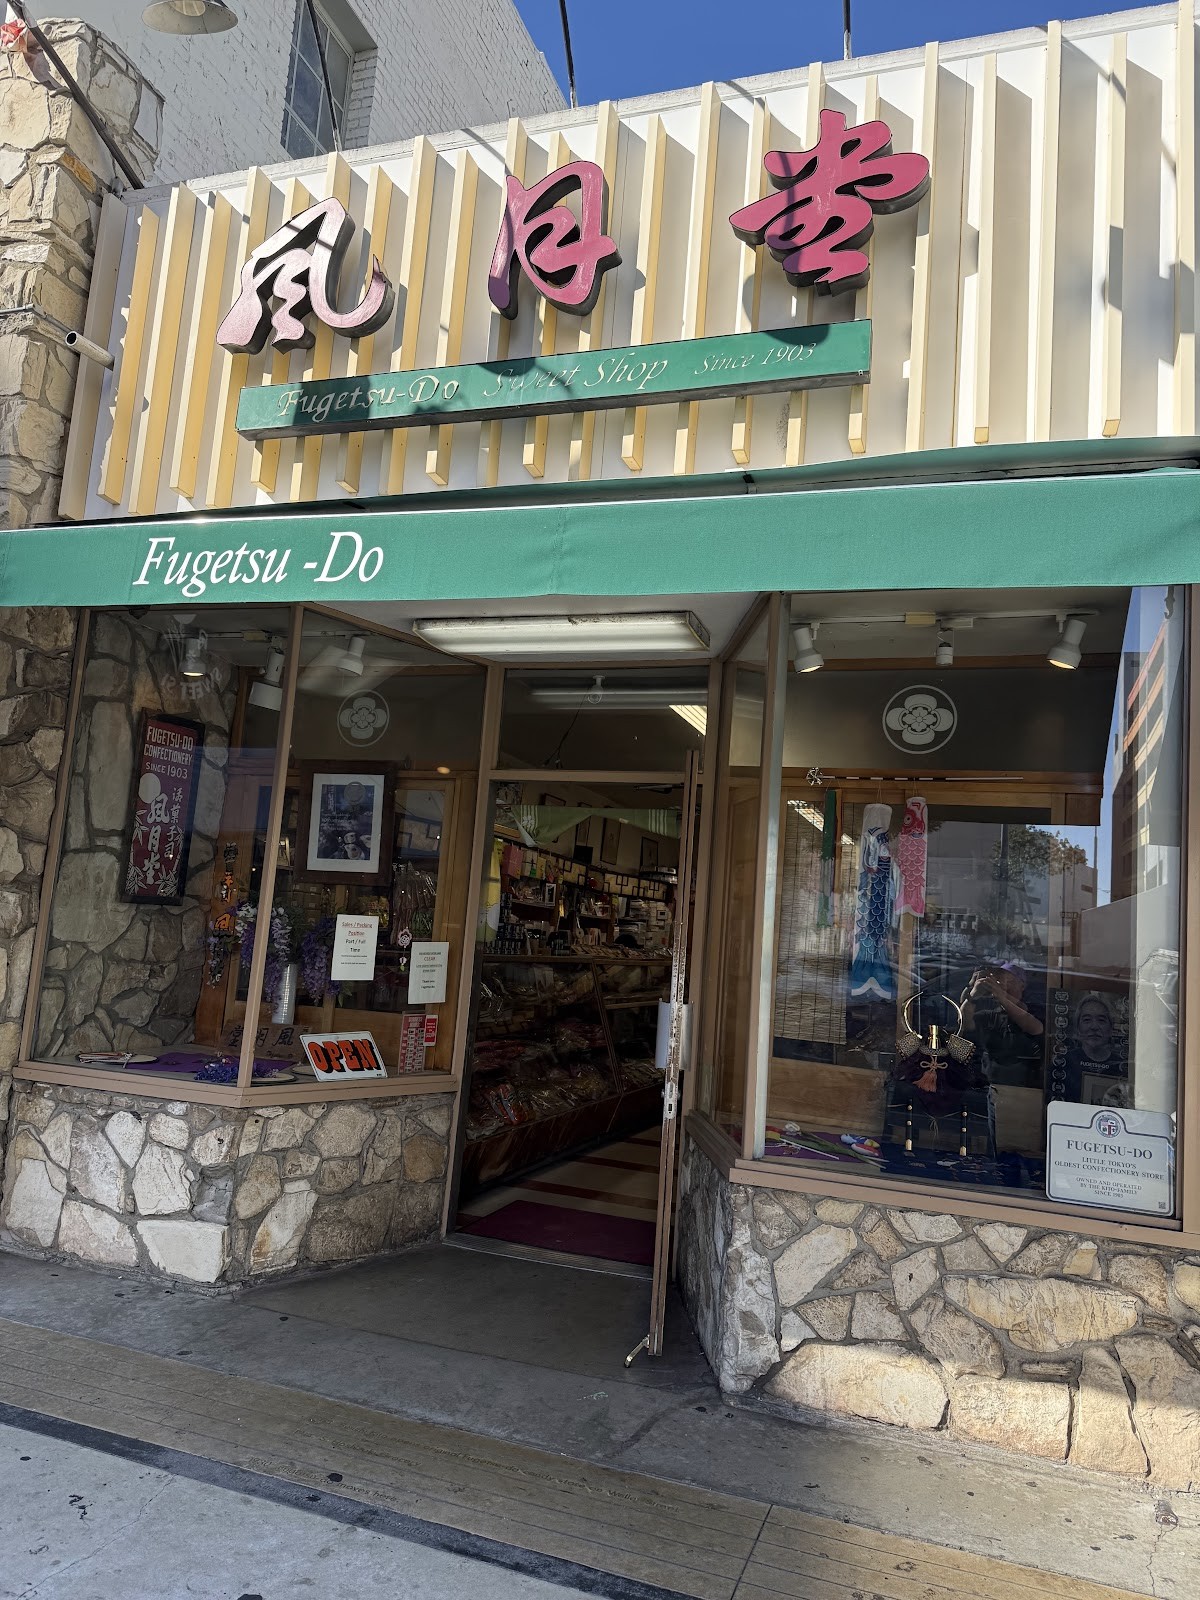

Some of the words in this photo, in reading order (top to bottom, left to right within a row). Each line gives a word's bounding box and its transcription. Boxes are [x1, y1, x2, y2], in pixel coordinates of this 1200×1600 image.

[277, 375, 460, 422] Fugetsu-Do
[483, 363, 581, 397] Sweet
[583, 352, 668, 391] Shop
[694, 352, 755, 375] Since
[761, 342, 817, 366] 1903
[132, 537, 291, 597] Fugetsu
[146, 726, 194, 752] FUGETSU-DO
[143, 744, 193, 767] CONFECTIONERY
[145, 761, 166, 774] SINCE
[167, 764, 188, 779] 1903
[142, 793, 171, 885] 風月堂
[307, 1038, 382, 1074] OPEN
[1080, 1061, 1110, 1070] FUGETSU-DO
[1066, 1139, 1153, 1160] FUGETSU-DO
[1054, 1160, 1081, 1169] OLDEST
[1082, 1164, 1140, 1177] CONFECTIONERY
[1141, 1172, 1165, 1180] STORE
[1082, 1157, 1106, 1166] LITTLE
[1108, 1160, 1137, 1169] TOKYO'S
[1112, 1181, 1142, 1190] OPERATED
